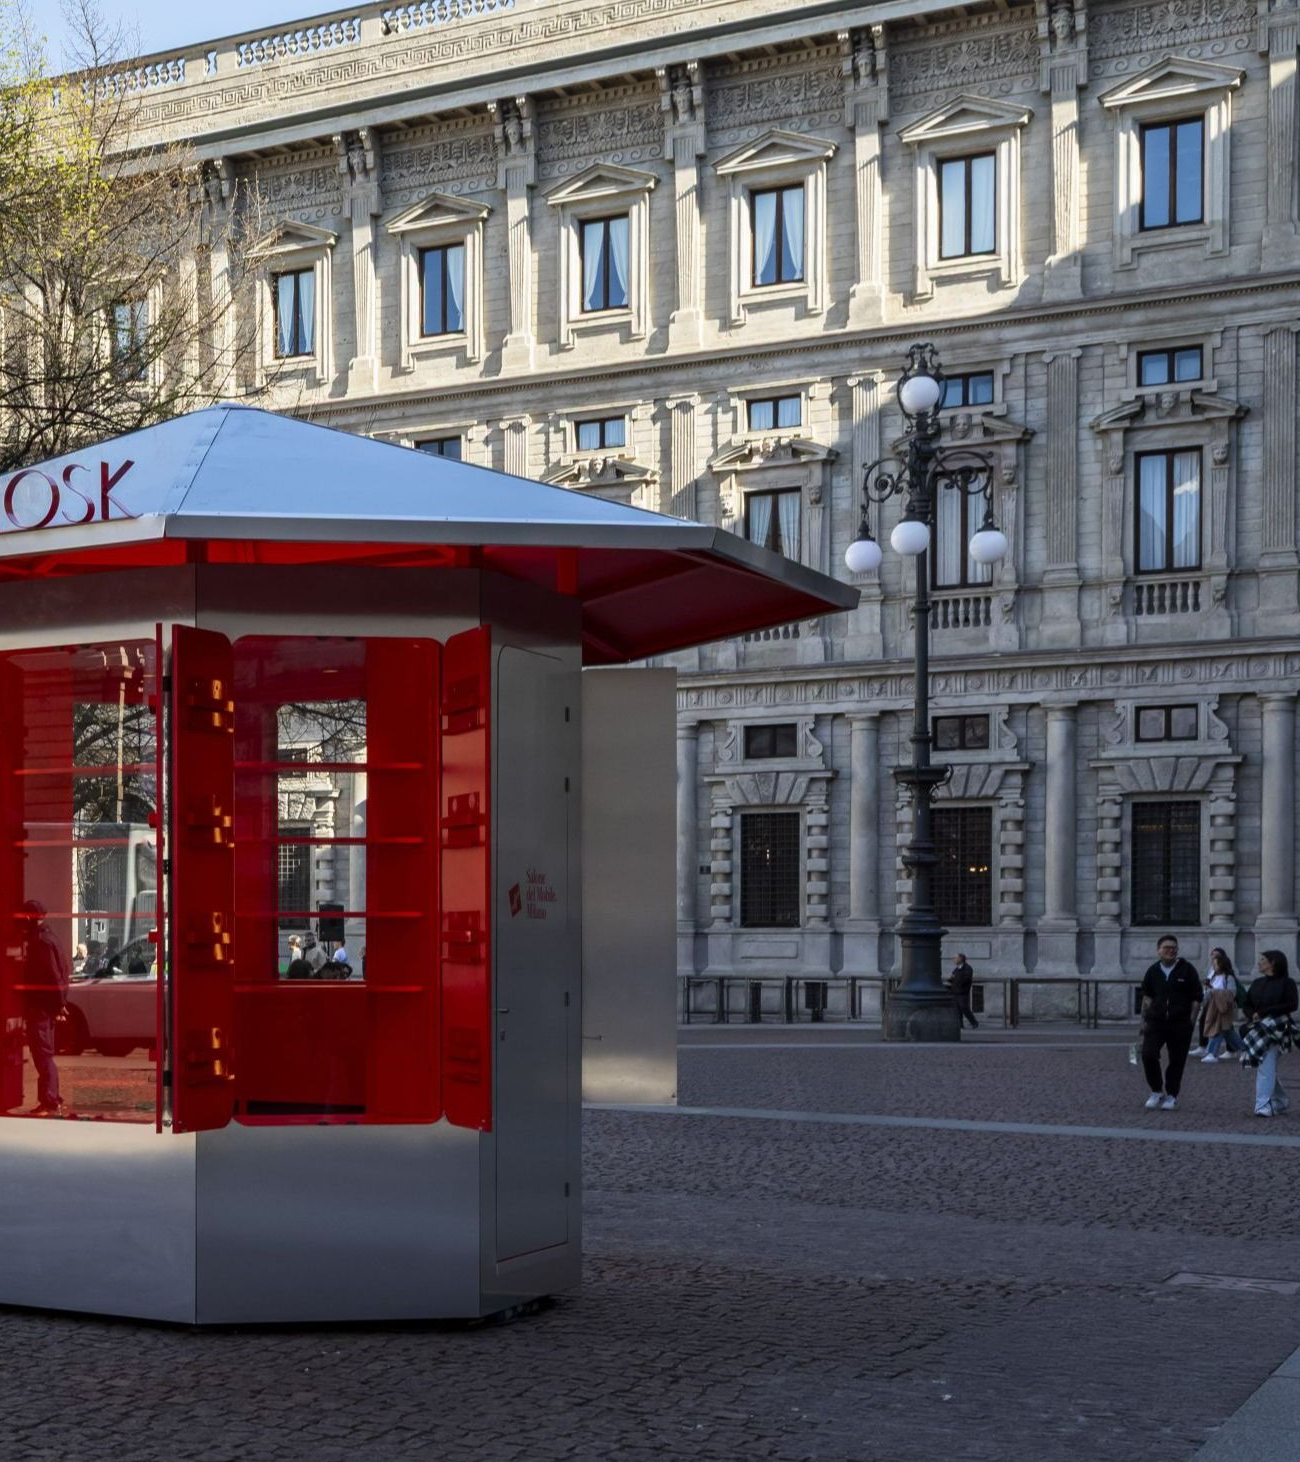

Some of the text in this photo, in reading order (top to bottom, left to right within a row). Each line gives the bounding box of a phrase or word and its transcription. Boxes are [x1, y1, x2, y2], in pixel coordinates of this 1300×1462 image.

[525, 867, 546, 885] Salone
[526, 885, 536, 901] del
[526, 903, 547, 920] Milano
